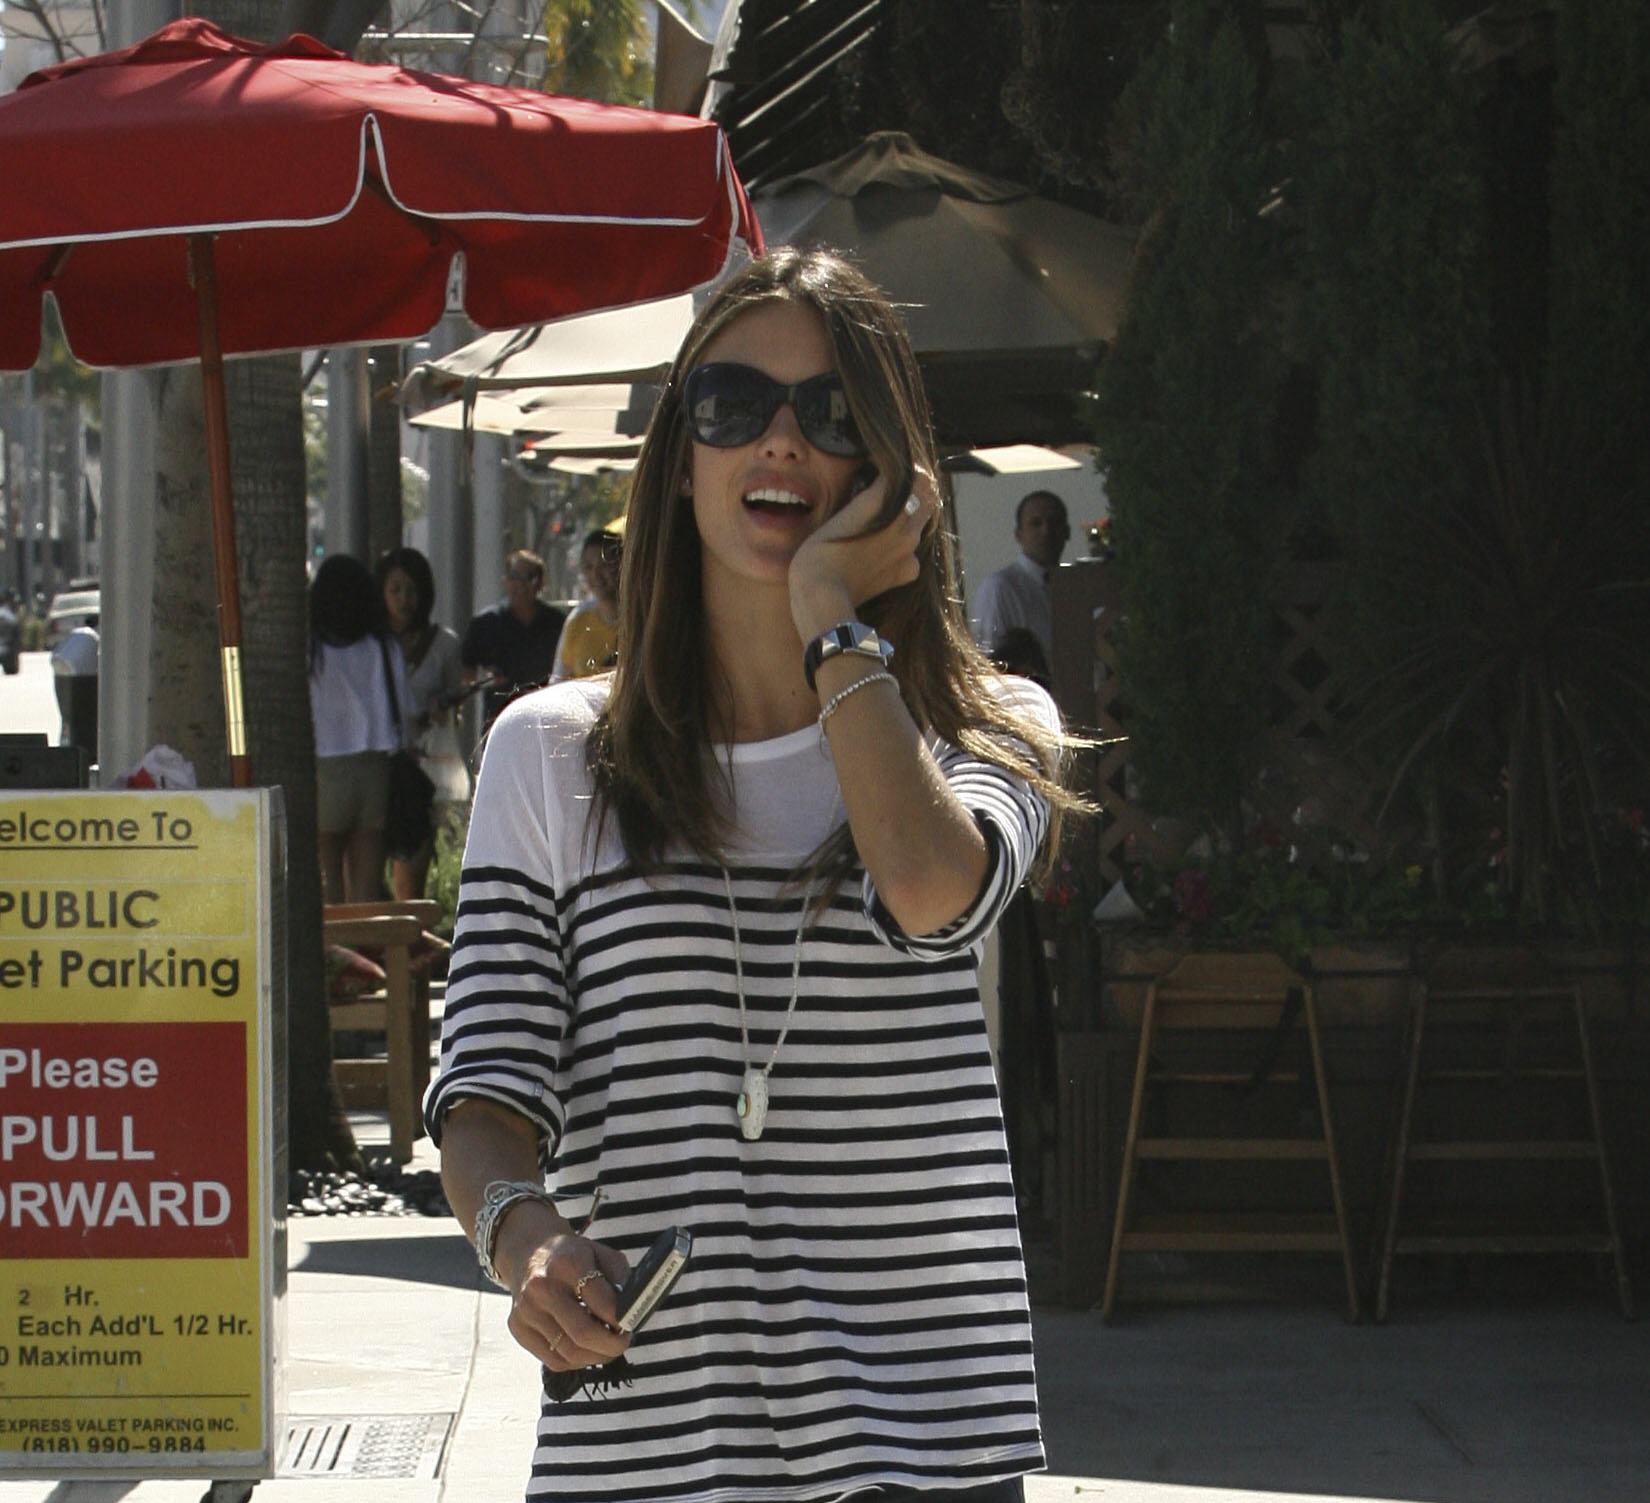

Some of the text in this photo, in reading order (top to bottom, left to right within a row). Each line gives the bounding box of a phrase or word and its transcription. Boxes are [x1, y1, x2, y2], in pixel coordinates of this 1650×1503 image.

[0, 811, 192, 842] elcome To
[0, 948, 240, 998] et Parking
[0, 1048, 159, 1089] Please
[2, 1115, 155, 1161] PULL
[0, 1181, 231, 1227] RWARD
[18, 1285, 99, 1306] 2 Hr.
[18, 1314, 252, 1336] Each Add'L 1/2 Hr.
[18, 1345, 142, 1366] Maximum
[0, 1417, 239, 1433] EXPRESS VALET PARKING INC.
[22, 1436, 79, 1452] (818)
